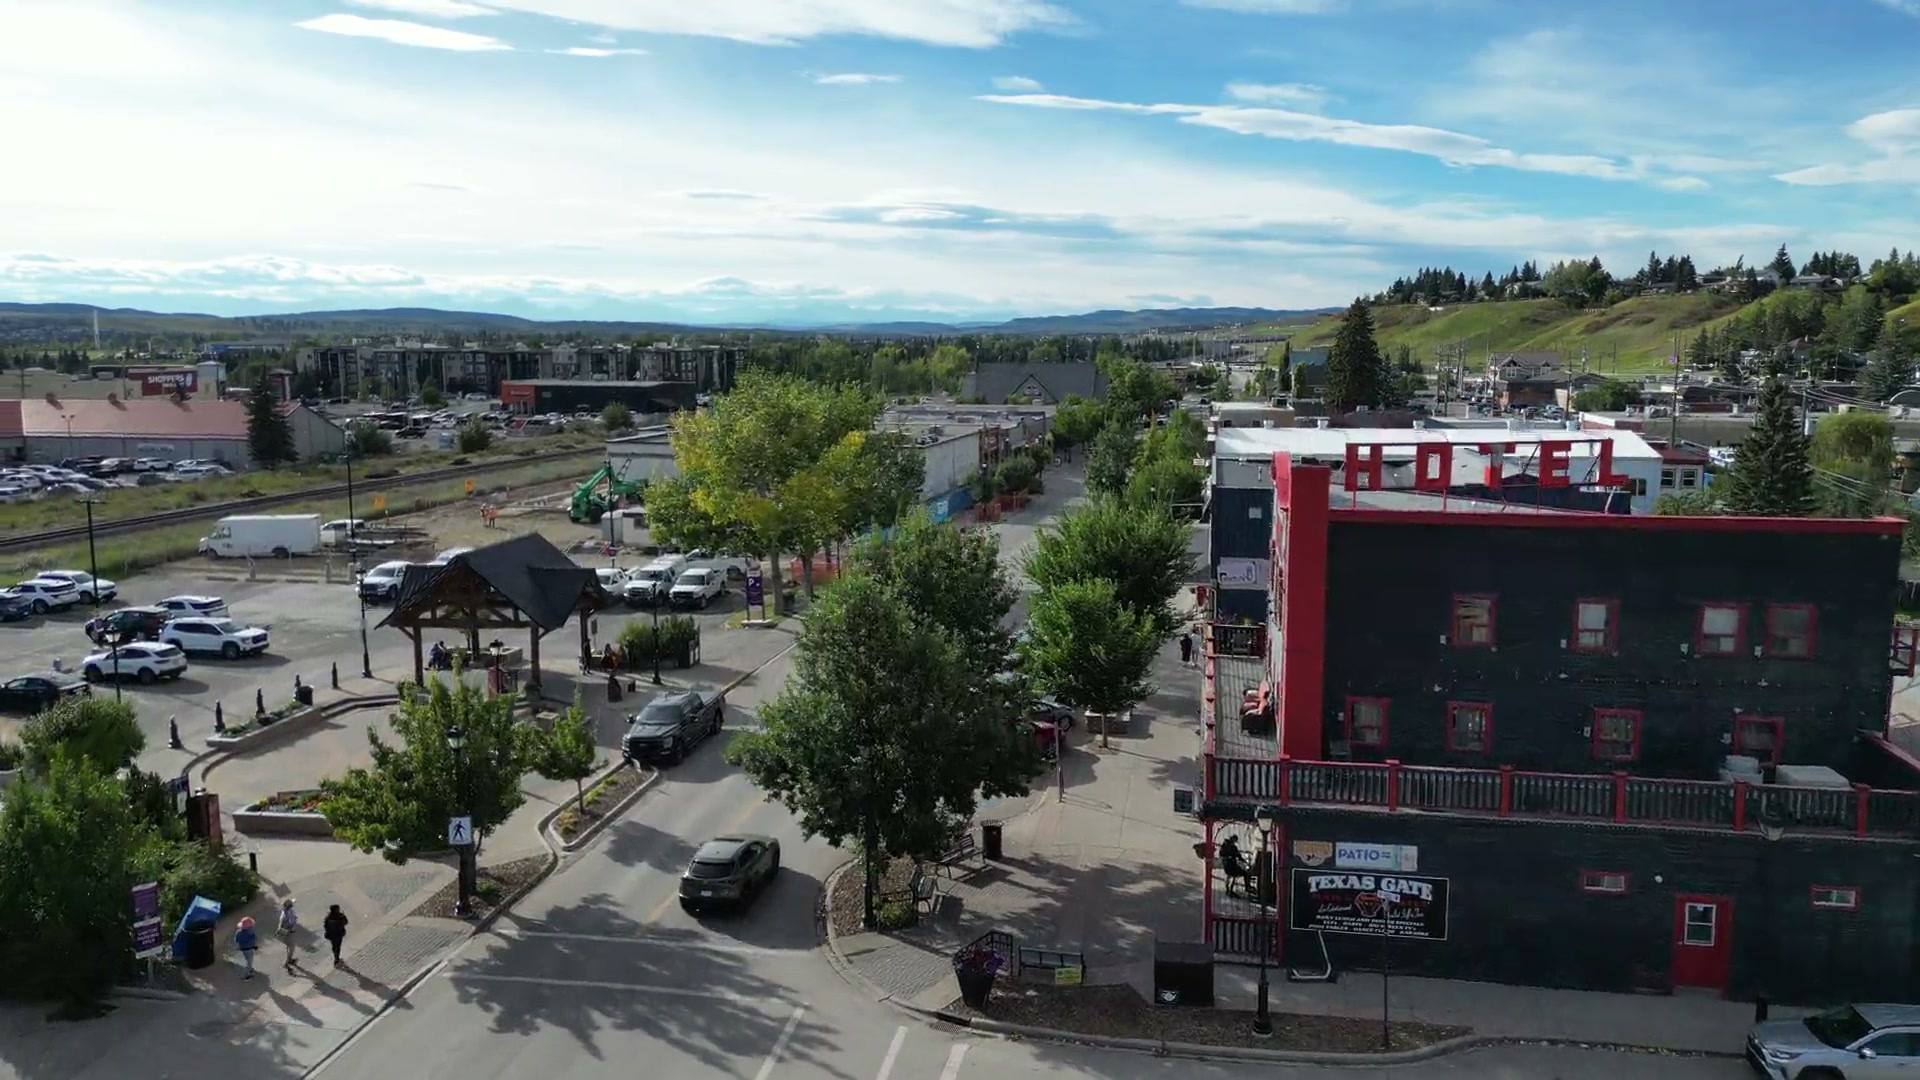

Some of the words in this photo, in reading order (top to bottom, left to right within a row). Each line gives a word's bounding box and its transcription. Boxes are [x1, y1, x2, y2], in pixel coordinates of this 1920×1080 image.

[1345, 438, 1629, 491] HOTEL
[1338, 848, 1379, 861] PATIO
[1308, 875, 1376, 893] TEXAS
[1380, 877, 1433, 901] GATE
